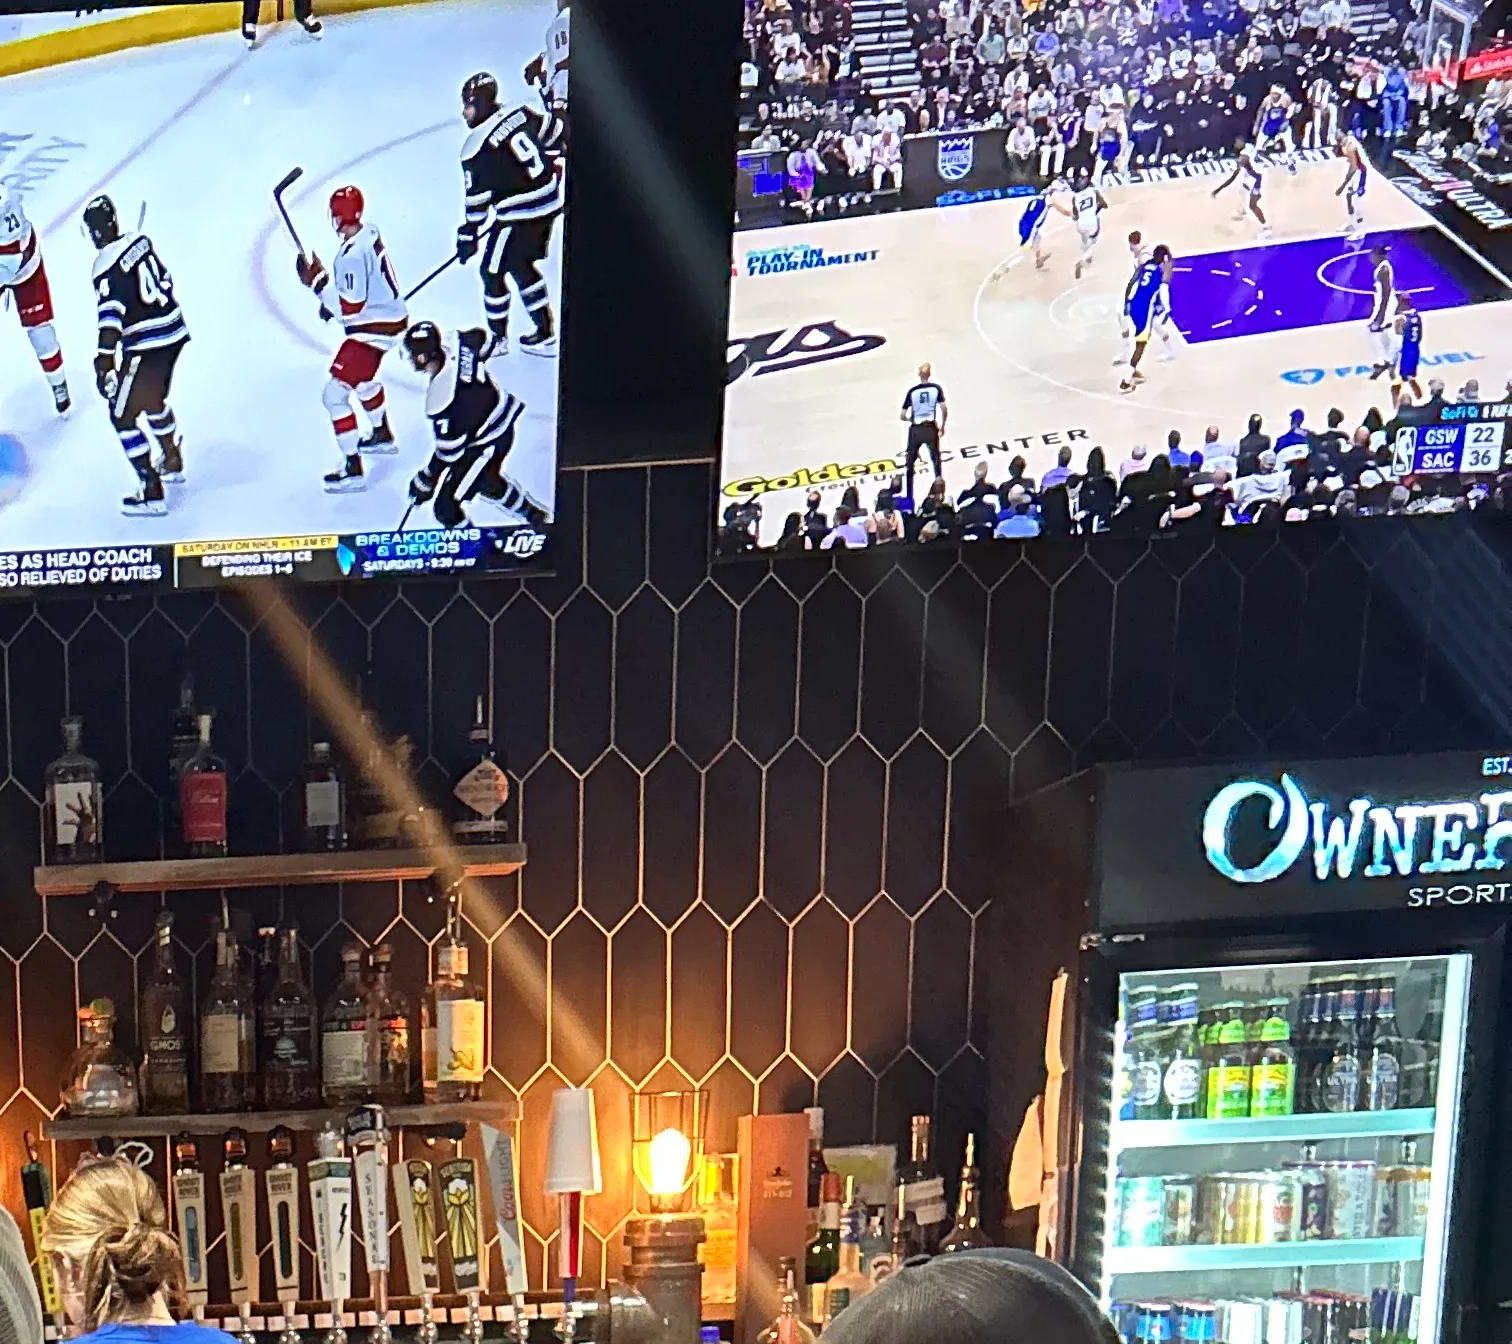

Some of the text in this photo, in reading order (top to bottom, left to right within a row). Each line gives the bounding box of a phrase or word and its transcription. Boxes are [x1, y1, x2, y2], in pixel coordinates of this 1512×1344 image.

[1424, 428, 1460, 446] GSW
[1471, 426, 1496, 444] 22
[1421, 450, 1455, 470] SAC
[1468, 449, 1493, 467] 36
[355, 528, 482, 547] BREAKDOWNS
[503, 534, 548, 554] LIVE
[182, 542, 234, 554] SATURDAY
[236, 541, 250, 551] ON
[376, 541, 461, 557] & DEMOS
[21, 552, 43, 569] AS
[46, 551, 91, 568] HEAD
[93, 547, 153, 565] COACH
[201, 550, 314, 567] DEFENDING THEIR ICE
[363, 558, 425, 572] SATURDAYS
[20, 568, 87, 586] RELIEVED
[88, 566, 109, 582] OF
[110, 564, 163, 582] DUTIES
[1407, 881, 1512, 908] SPORT
